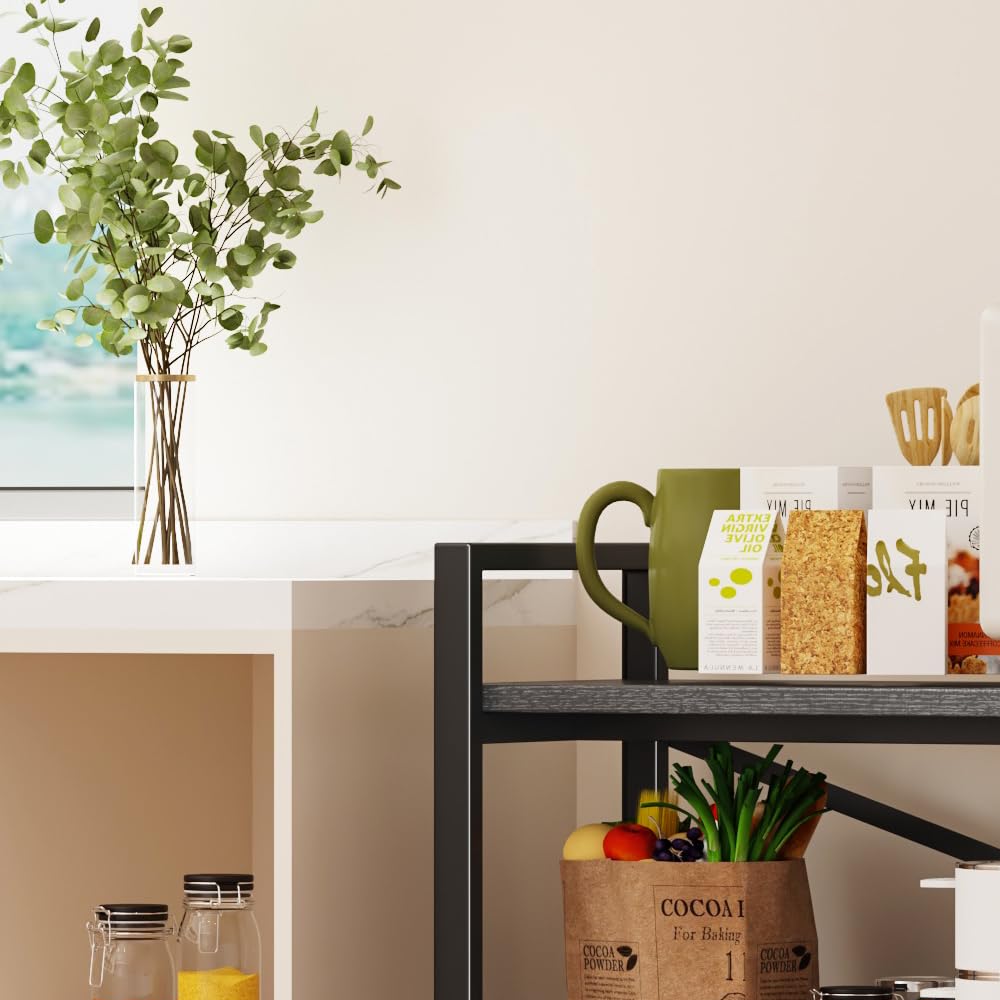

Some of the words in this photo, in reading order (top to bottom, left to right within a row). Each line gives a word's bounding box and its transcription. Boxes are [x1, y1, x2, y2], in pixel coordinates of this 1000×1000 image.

[660, 898, 733, 918] COCOA
[673, 926, 697, 941] For
[701, 926, 743, 945] Baking
[583, 944, 615, 958] COCOA
[760, 947, 790, 961] COCOA
[583, 957, 625, 972] POWDER
[760, 960, 797, 974] POWDER
